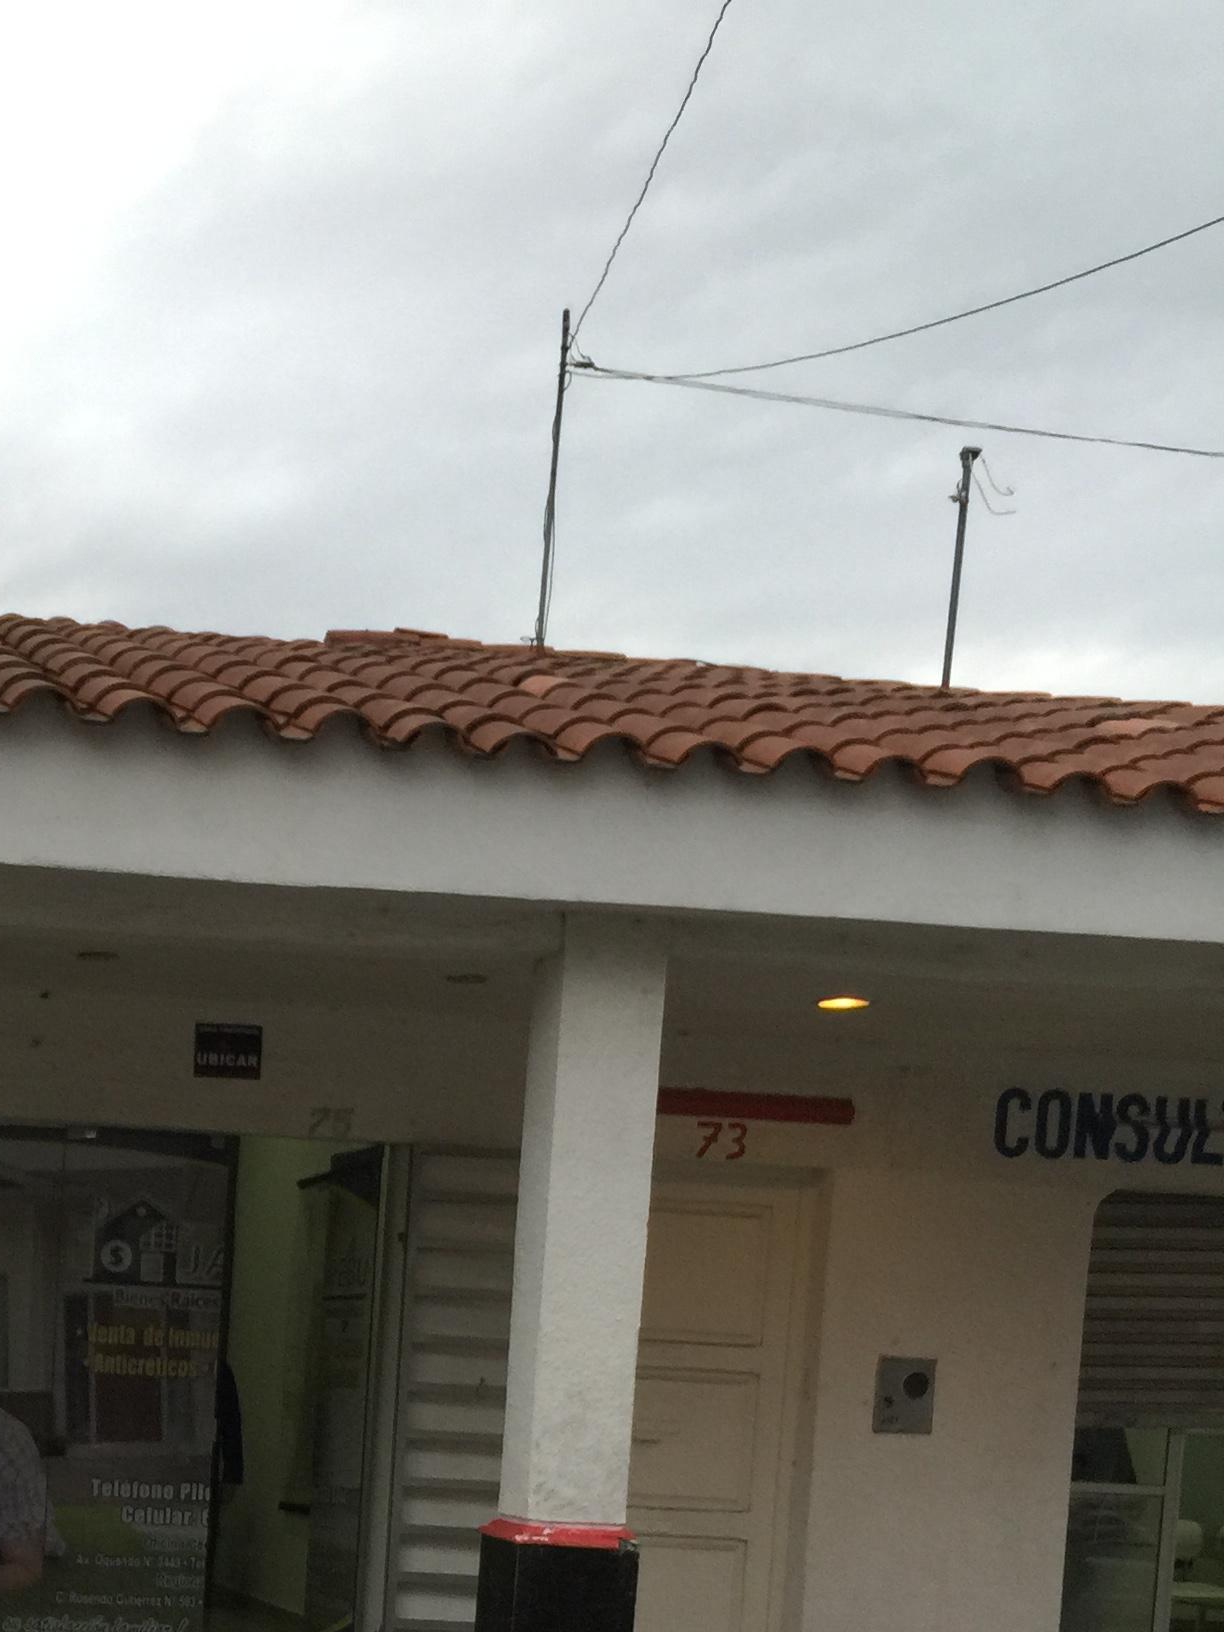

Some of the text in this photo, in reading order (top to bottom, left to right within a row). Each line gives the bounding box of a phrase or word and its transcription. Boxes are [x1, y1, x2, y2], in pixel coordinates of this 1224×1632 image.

[196, 1052, 258, 1069] UBICAR
[695, 1120, 749, 1161] 73
[994, 1087, 1224, 1166] CONSUL
[143, 1324, 164, 1346] de
